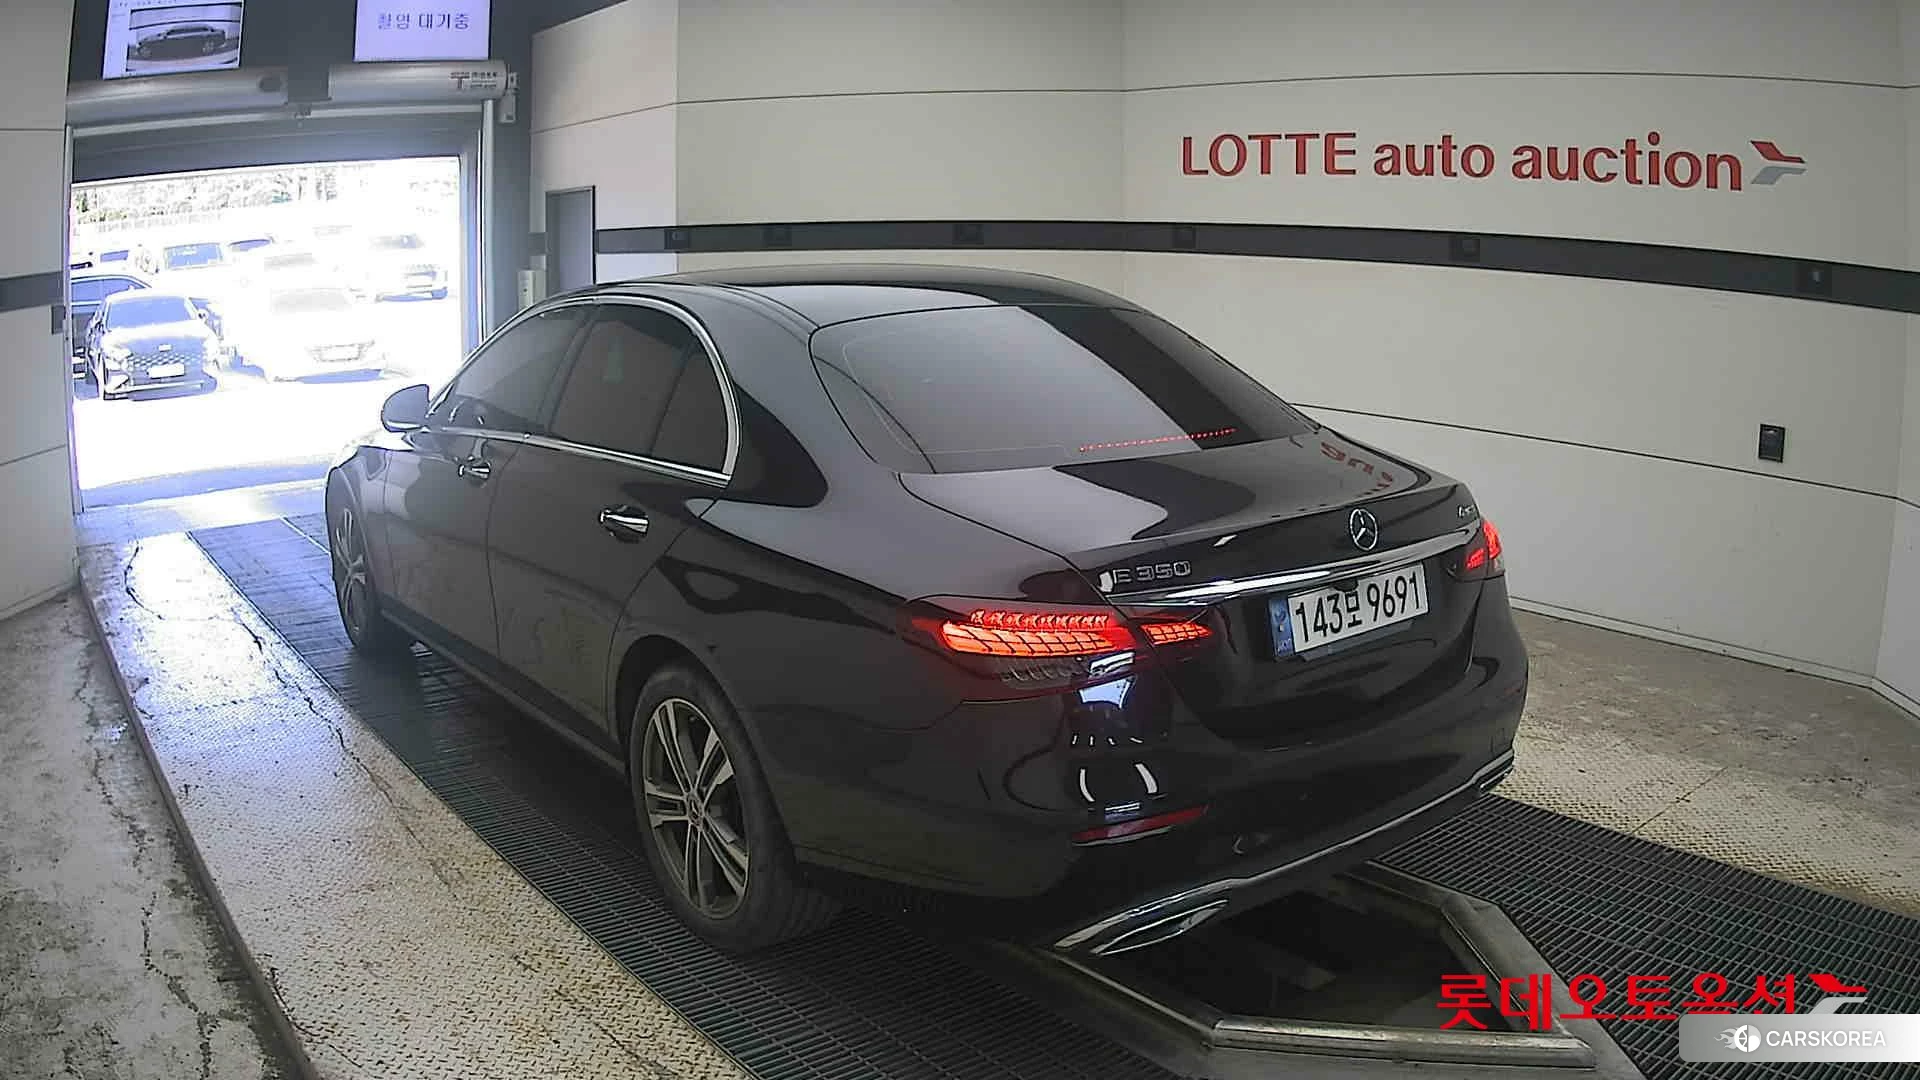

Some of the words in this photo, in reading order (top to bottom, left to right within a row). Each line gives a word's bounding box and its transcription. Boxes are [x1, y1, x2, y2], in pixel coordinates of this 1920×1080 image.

[1182, 132, 1357, 177] LOTTE
[1373, 135, 1495, 178] auto
[1511, 131, 1742, 191] auction
[1112, 568, 1132, 585] E
[1136, 560, 1191, 581] 350
[1366, 571, 1420, 622] 9691
